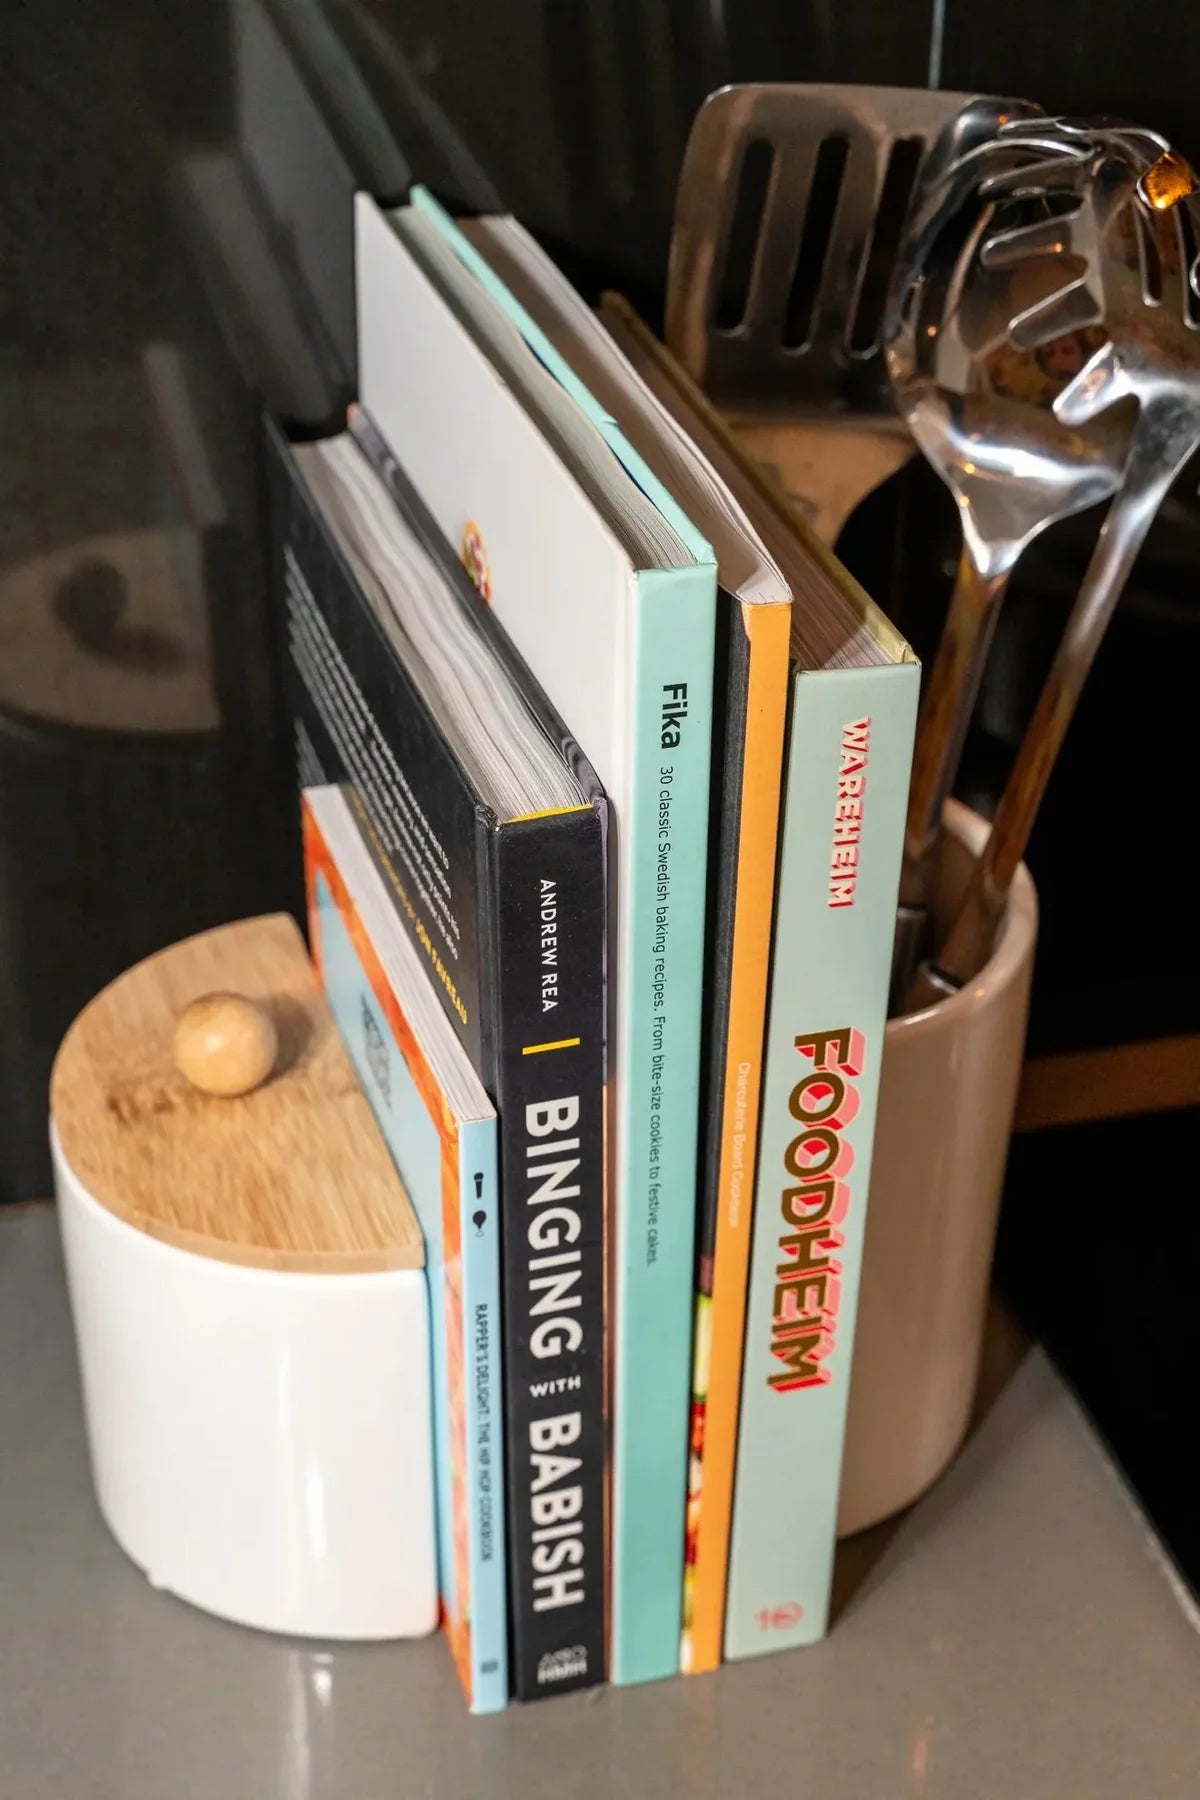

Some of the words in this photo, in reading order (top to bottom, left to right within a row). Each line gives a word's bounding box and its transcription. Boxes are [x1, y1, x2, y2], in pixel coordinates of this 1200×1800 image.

[661, 683, 687, 749] Fika
[660, 766, 673, 784] 30
[659, 790, 673, 838] classic
[827, 716, 873, 910] WAREHEIM
[657, 843, 672, 901] Swedish
[540, 879, 558, 966] ANDREW
[652, 906, 669, 952] baking
[541, 973, 558, 1013] REA
[652, 957, 668, 1012] recipes.
[653, 1016, 666, 1051] From
[651, 1054, 665, 1111] bite-size
[650, 1114, 663, 1163] cookies
[649, 1165, 661, 1180] to
[525, 1095, 583, 1359] BINGING
[648, 1183, 662, 1225] festive
[767, 1025, 866, 1394] FOODHEIM
[476, 1303, 489, 1363] RAPPER'S
[530, 1375, 582, 1398] WITH
[529, 1411, 585, 1612] BABISH
